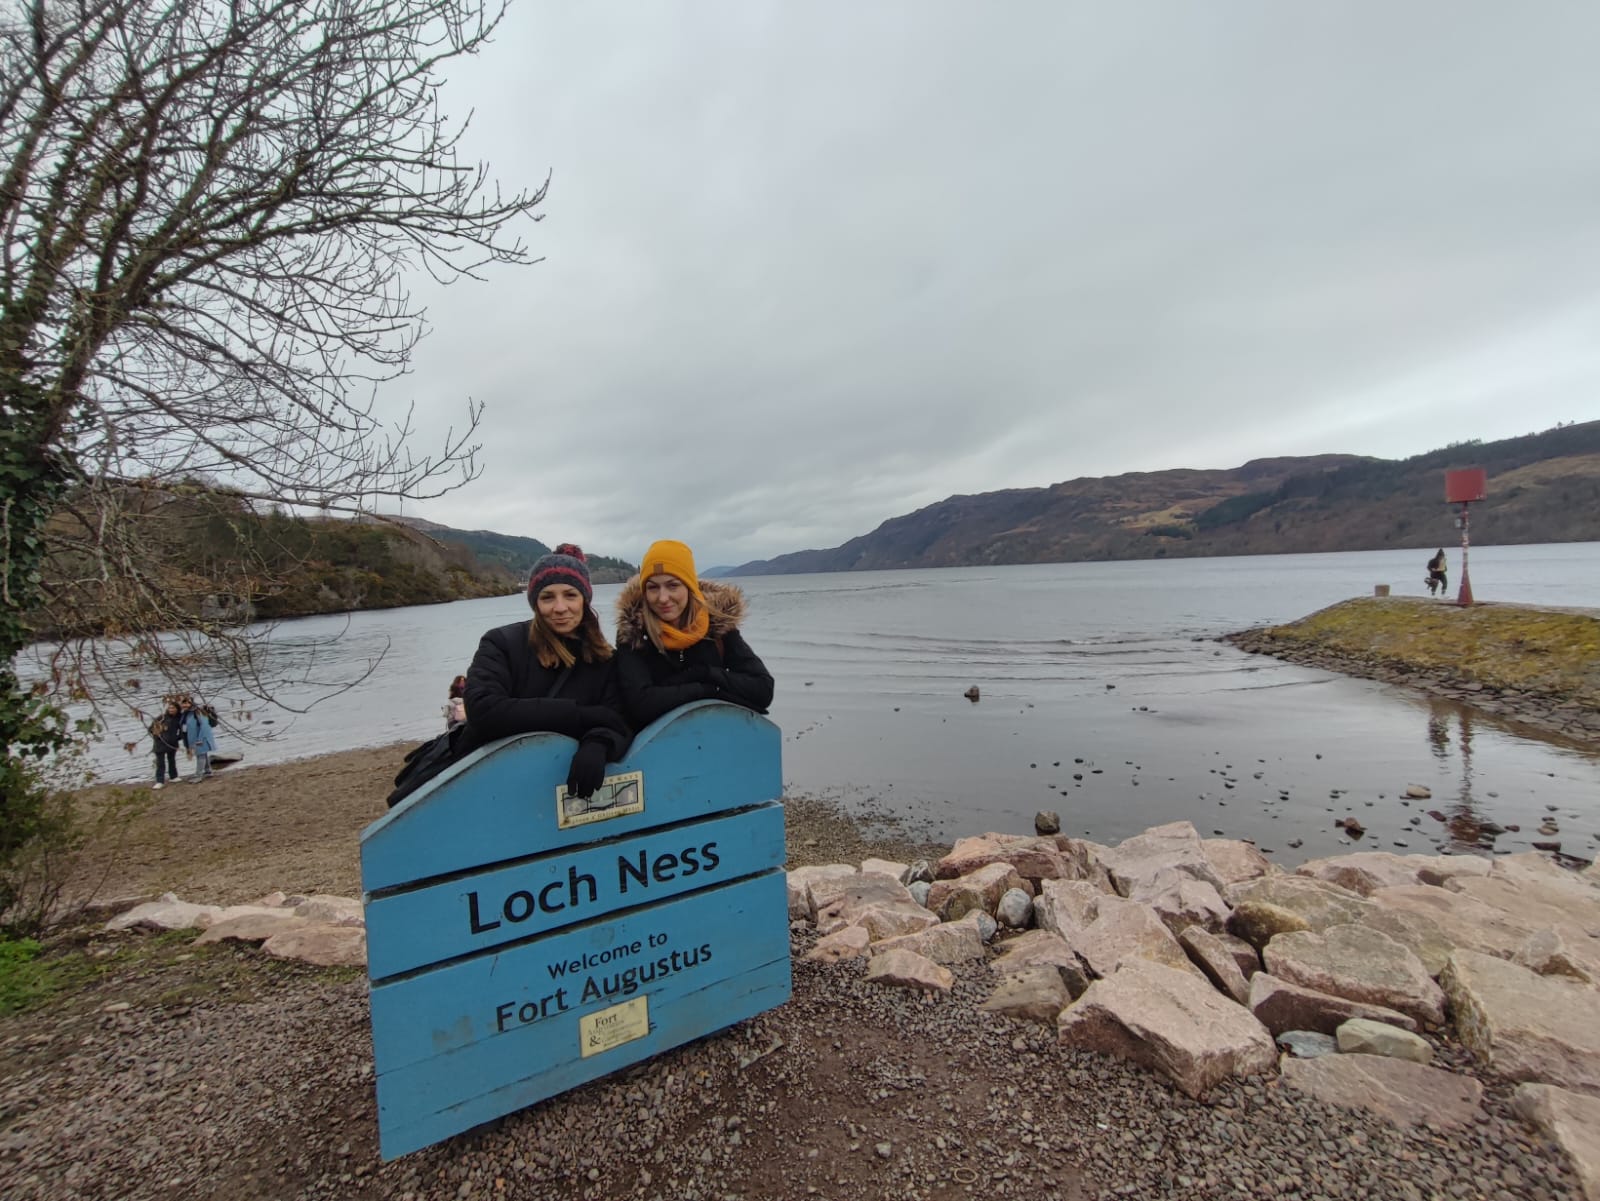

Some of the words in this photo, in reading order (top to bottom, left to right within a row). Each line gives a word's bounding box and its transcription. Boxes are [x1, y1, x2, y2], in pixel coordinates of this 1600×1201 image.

[467, 865, 598, 934] Loch
[618, 841, 720, 893] Ness
[496, 987, 569, 1032] Fort
[579, 943, 713, 1004] Augustus
[547, 938, 642, 980] Welcome
[648, 932, 668, 948] to
[595, 1013, 617, 1028] Fort
